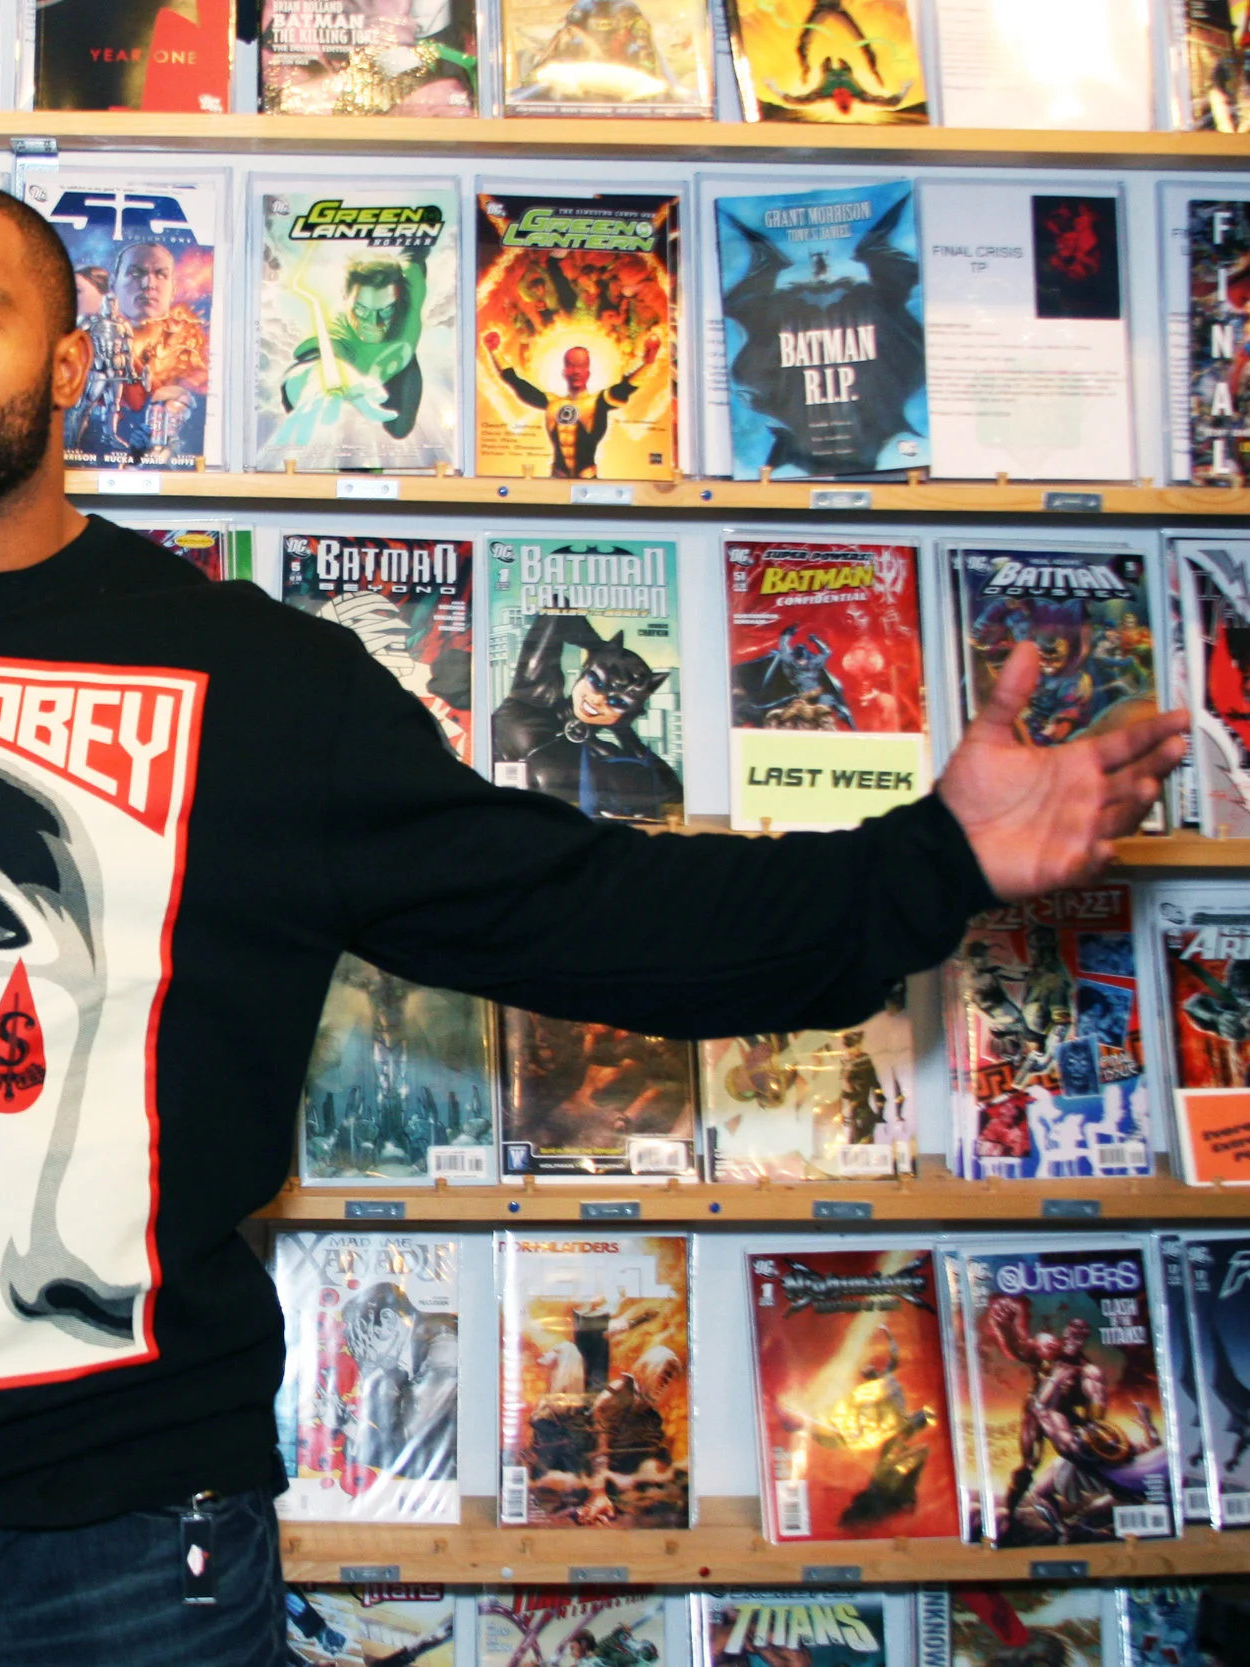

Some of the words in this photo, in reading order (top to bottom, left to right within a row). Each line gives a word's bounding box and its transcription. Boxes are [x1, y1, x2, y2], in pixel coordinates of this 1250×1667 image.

[272, 14, 366, 29] BATMAN
[273, 29, 296, 44] THE
[298, 29, 349, 44] KILLING
[90, 48, 141, 62] YEAR
[153, 50, 198, 65] ONE
[307, 199, 425, 224] GREEN
[519, 207, 636, 236] GREEN
[764, 207, 805, 228] GRANT
[807, 200, 871, 226] MORRISON
[290, 216, 445, 240] LANTERN
[502, 223, 655, 252] LANTERN
[931, 245, 969, 258] FINAL
[974, 247, 1024, 259] CRISIS
[969, 262, 989, 274] TP
[778, 325, 878, 368] BATMAN
[803, 366, 860, 406] R.I.P.
[104, 455, 134, 464] RUCKA
[316, 539, 458, 584] BATMAN
[520, 545, 666, 585] BATMAN
[764, 551, 809, 560] SUPER
[760, 564, 876, 595] BATMAN
[989, 561, 1125, 591] BATMAN
[318, 583, 456, 594] BEYOND
[775, 592, 868, 607] CONFIDENTIAL
[983, 587, 1132, 598] ODYSSEY
[520, 584, 669, 618] CATWOMAN
[748, 766, 823, 787] LAST
[830, 770, 914, 790] WEEK
[1101, 1298, 1138, 1316] CLASH
[1099, 1327, 1147, 1345] TITANS!
[723, 1603, 881, 1654] TITANS
